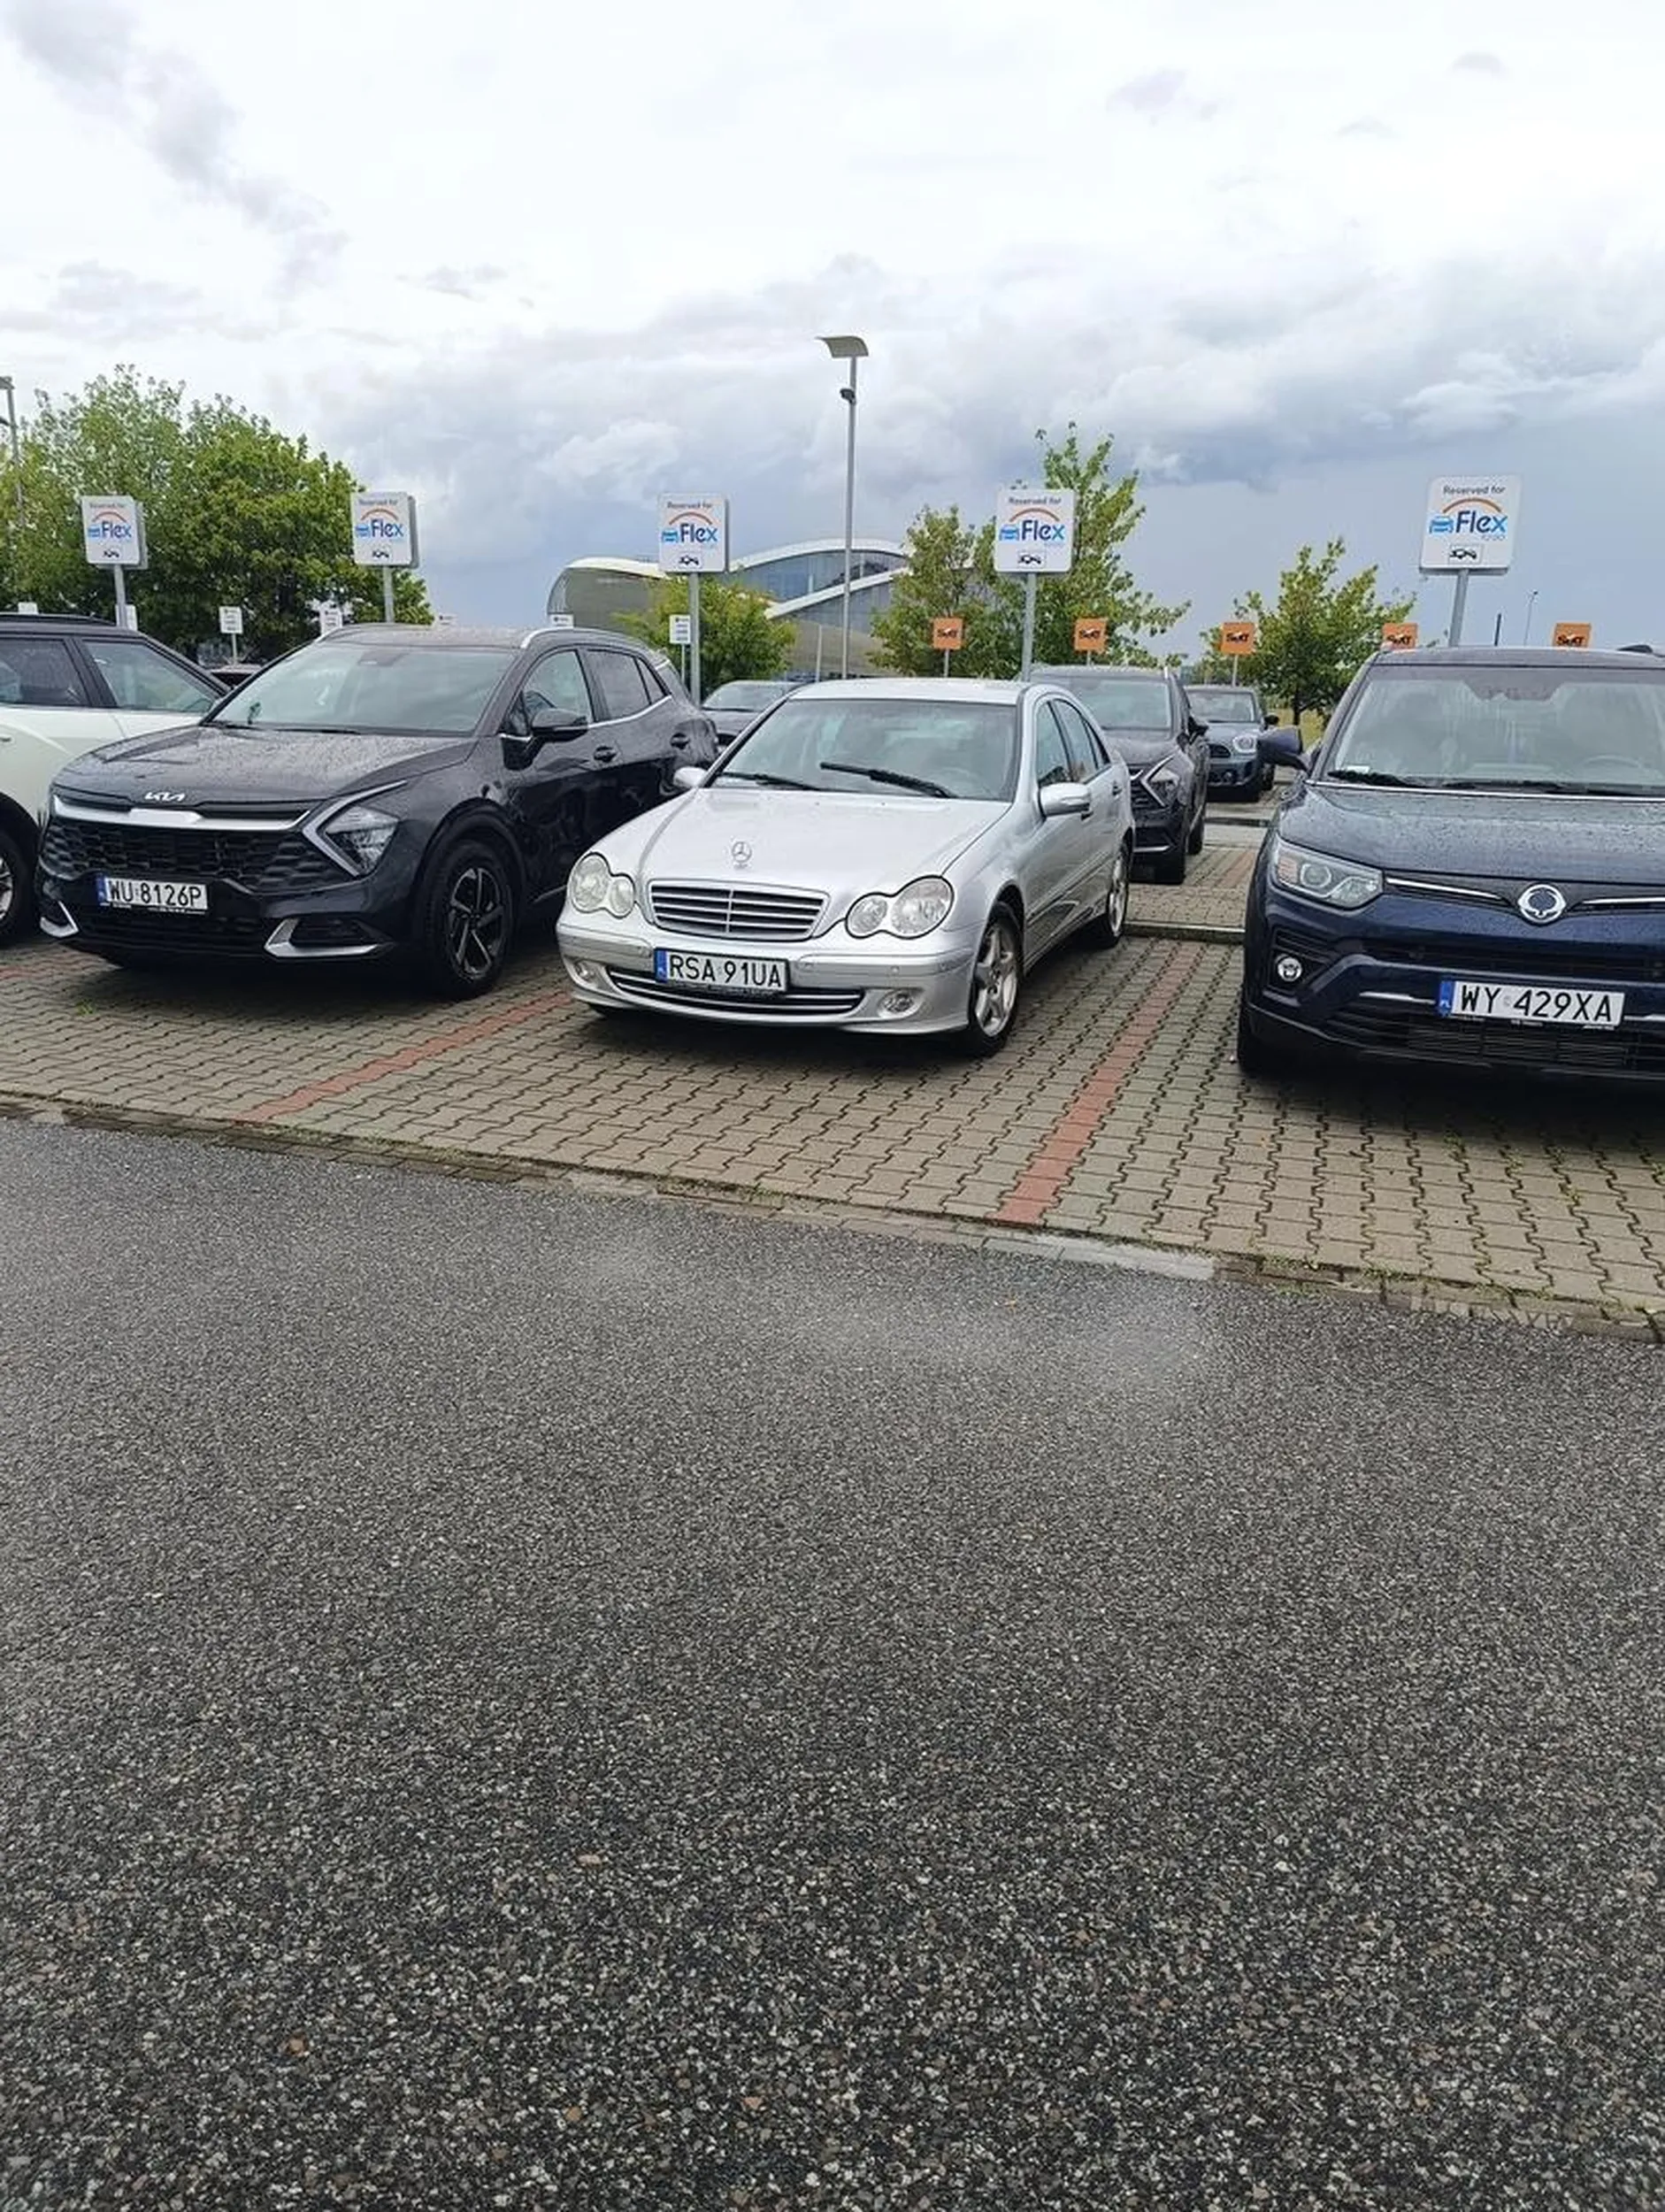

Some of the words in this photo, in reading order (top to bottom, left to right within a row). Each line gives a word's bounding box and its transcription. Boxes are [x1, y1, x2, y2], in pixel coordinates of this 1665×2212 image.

[1443, 485, 1490, 495] Reserved
[1491, 485, 1507, 495] for
[102, 520, 133, 539] Flex
[372, 518, 404, 538] Flex
[680, 523, 718, 542] Flex
[1021, 519, 1065, 541] Flex
[1455, 511, 1508, 534] Flex
[145, 792, 186, 803] KIA
[108, 880, 134, 902] WU
[140, 882, 202, 907] 8126P
[669, 954, 716, 982] RSA
[724, 960, 782, 987] 91UA
[1462, 985, 1501, 1014] WY
[1513, 988, 1611, 1022] 429XA
